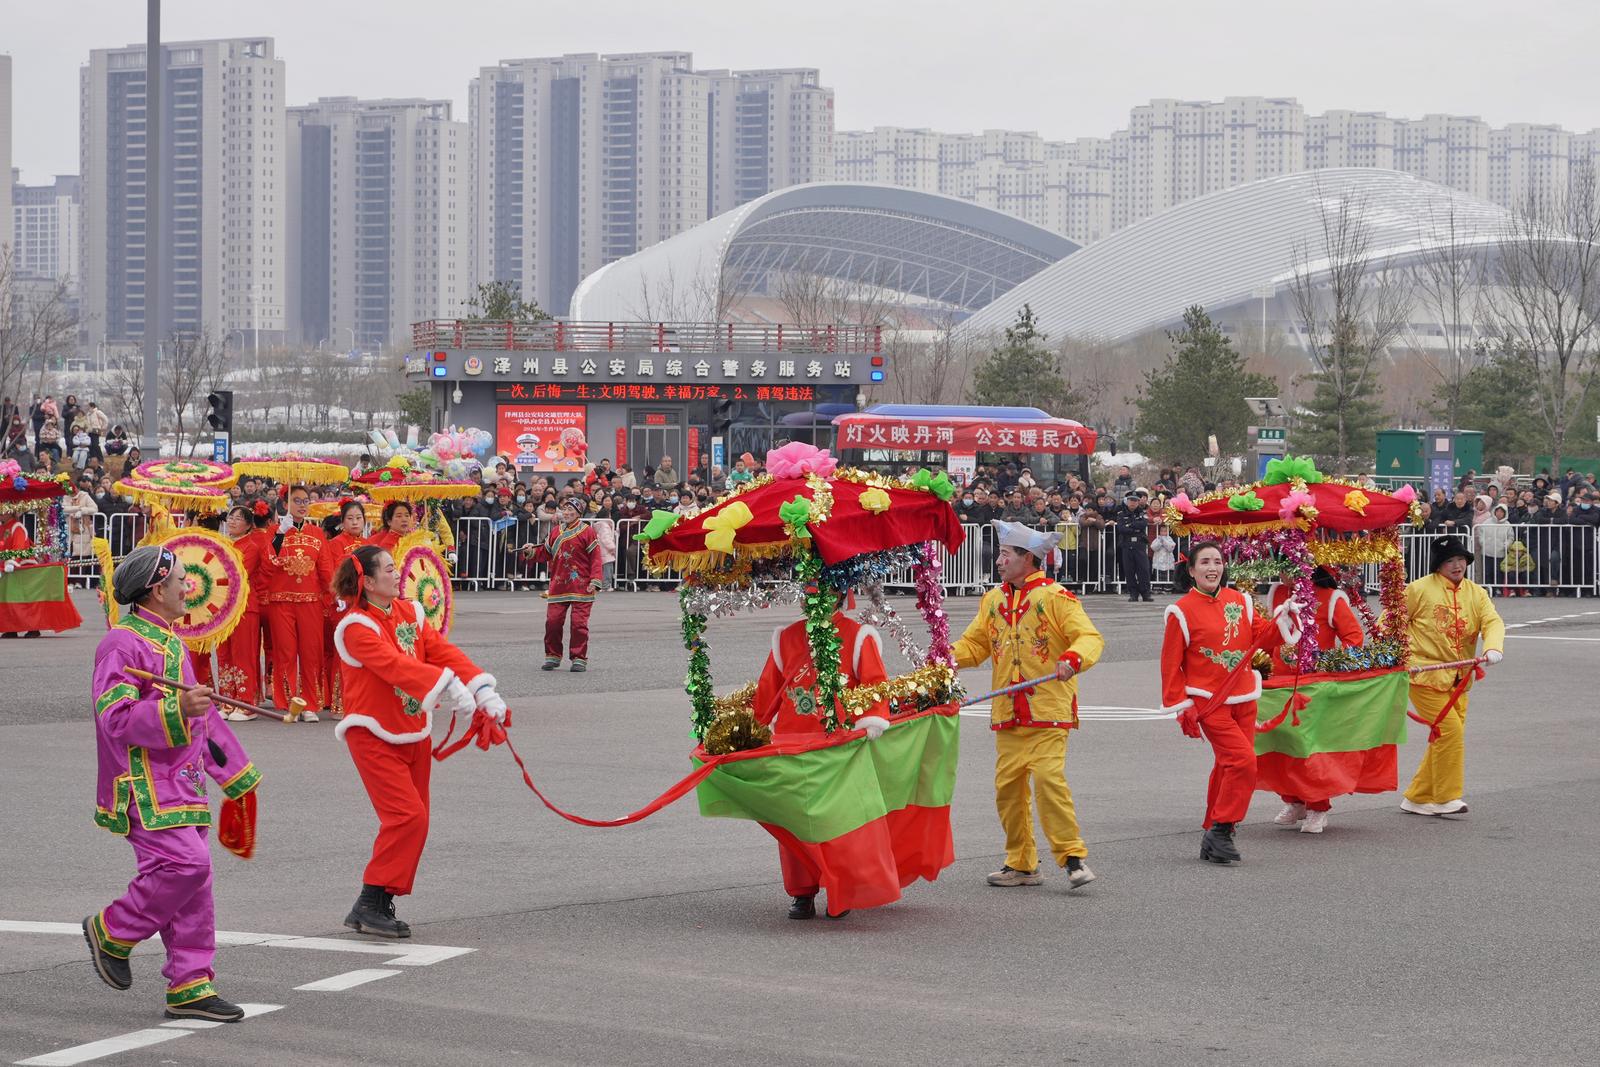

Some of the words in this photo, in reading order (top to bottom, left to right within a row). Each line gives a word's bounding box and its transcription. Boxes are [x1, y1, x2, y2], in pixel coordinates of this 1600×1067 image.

[494, 358, 851, 377] 泽州县公安局综合警务服务站
[846, 424, 954, 443] 灯火映丹河
[975, 428, 1082, 448] 公交暖民心
